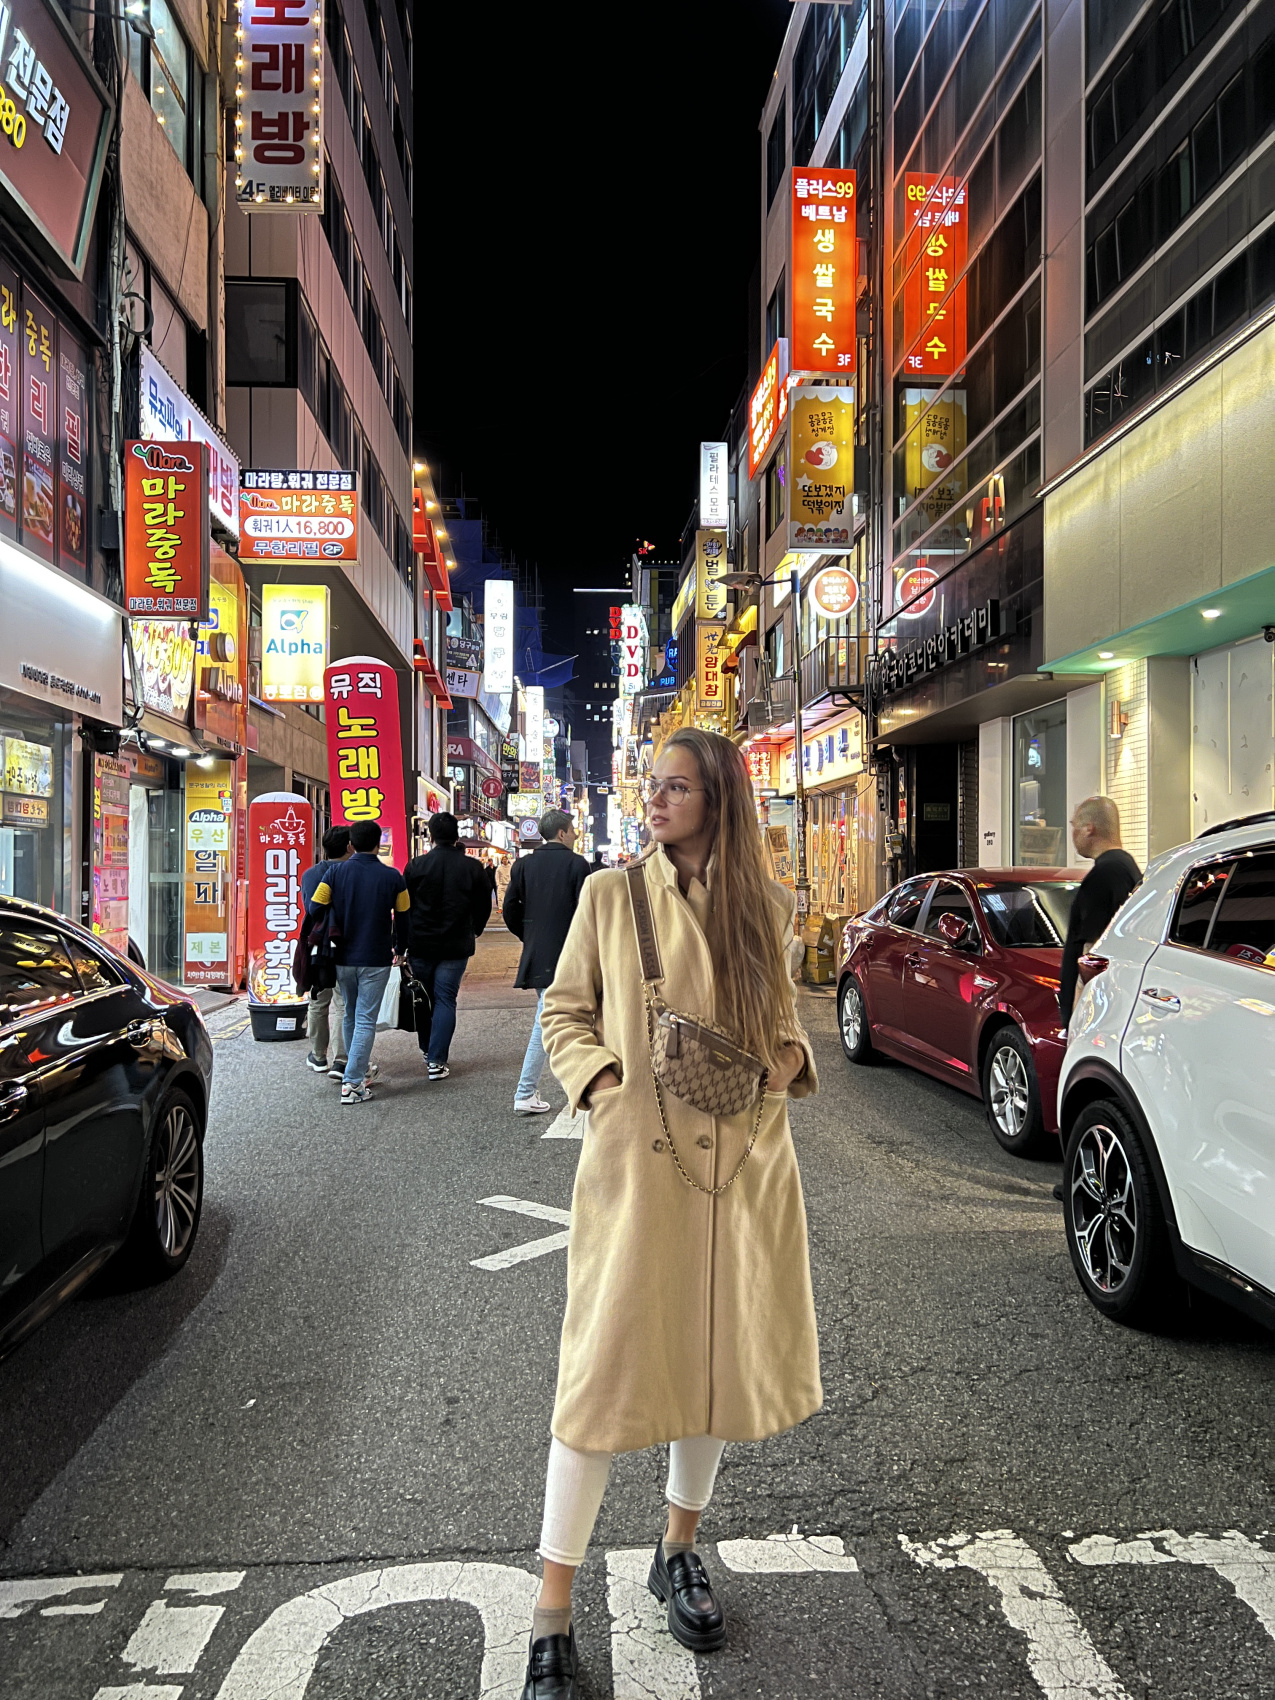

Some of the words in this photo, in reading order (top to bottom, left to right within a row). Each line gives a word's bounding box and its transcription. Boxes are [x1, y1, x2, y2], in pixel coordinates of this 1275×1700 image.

[5, 26, 70, 155] 전문점
[241, 180, 266, 198] 4F
[795, 178, 854, 198] 플러스99
[801, 205, 848, 223] 베트남
[813, 228, 835, 356] 생쌀국수
[26, 308, 52, 373] 중독
[837, 353, 852, 366] 3F
[30, 374, 48, 436] 리
[808, 411, 834, 427] 몽글몽글
[65, 406, 81, 465] 필
[188, 417, 234, 519] 래방
[245, 471, 313, 490] 마라탕,훠궈
[316, 473, 352, 490] 전문점
[281, 494, 355, 516] 마라중독
[802, 499, 845, 516] 떡볶이집
[141, 475, 186, 594] 마라중독
[296, 520, 346, 537] 16,800
[253, 541, 320, 557] 무한리필
[324, 545, 342, 555] 2F
[175, 598, 197, 610] 전문점
[609, 606, 622, 639] DVD
[266, 638, 323, 656] Alpha
[626, 625, 639, 677] DVD
[330, 672, 382, 700] 뮤직
[659, 676, 676, 686] PUB
[704, 656, 719, 697] 양대창
[337, 706, 385, 822] 노래방
[191, 811, 225, 823] Alpha
